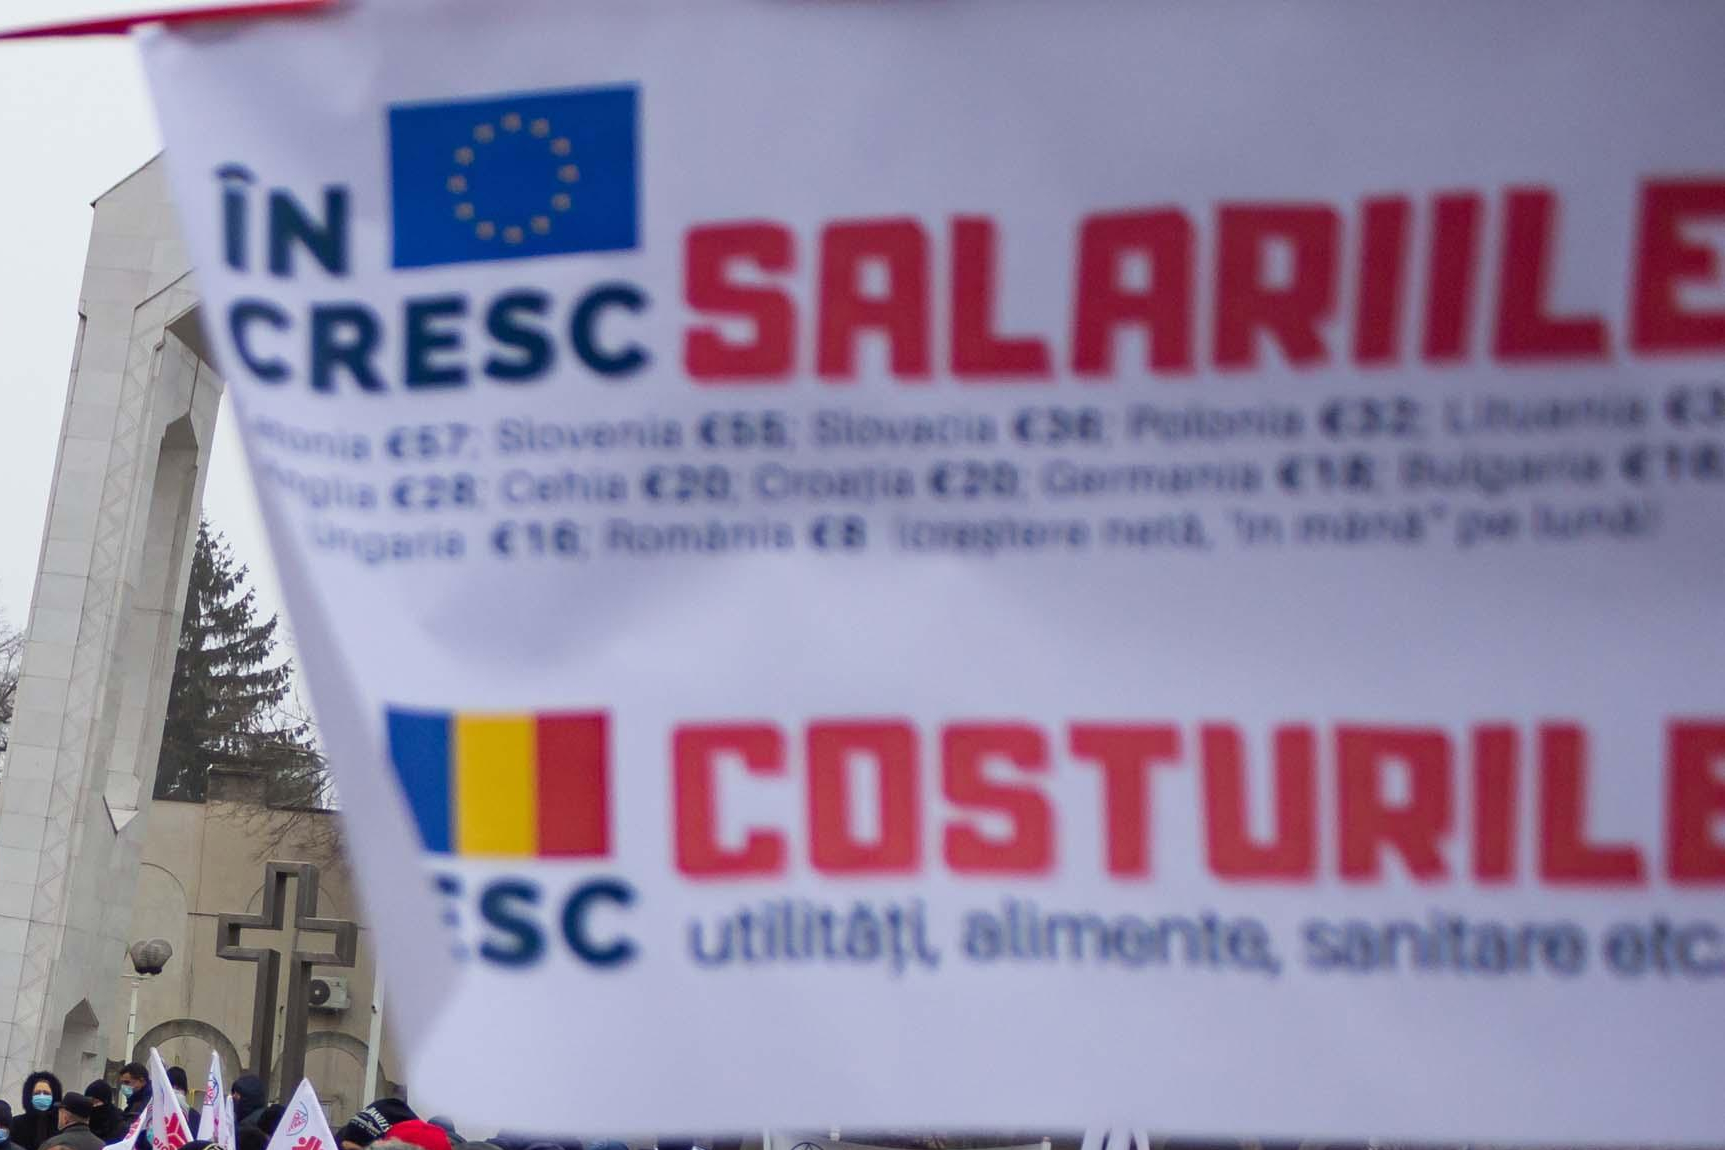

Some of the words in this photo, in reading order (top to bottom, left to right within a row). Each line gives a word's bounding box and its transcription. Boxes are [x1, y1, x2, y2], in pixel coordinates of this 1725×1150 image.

[213, 163, 350, 278] ÎN
[228, 284, 652, 393] CRESC
[683, 174, 1725, 386] SALARIILE
[494, 415, 683, 454] Slovenia
[671, 715, 1725, 888] COSTURILE
[1301, 904, 1587, 977] sanitare
